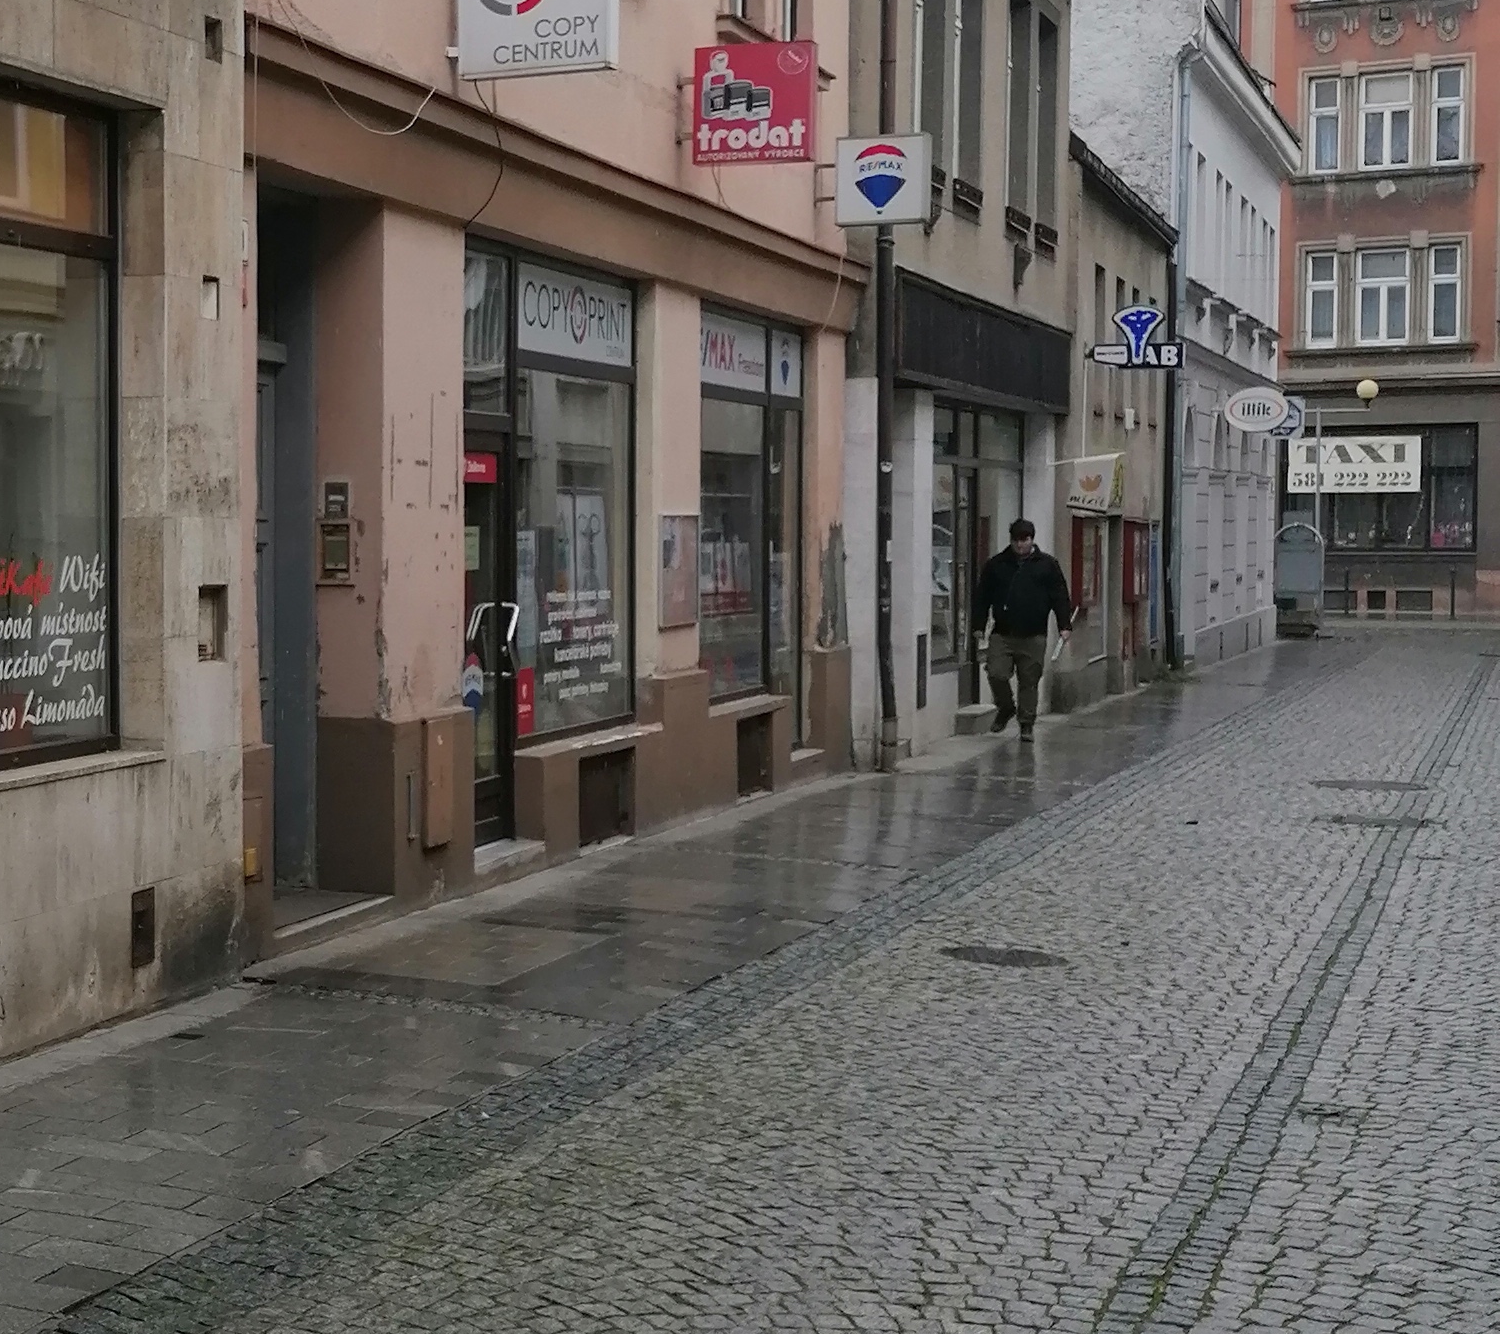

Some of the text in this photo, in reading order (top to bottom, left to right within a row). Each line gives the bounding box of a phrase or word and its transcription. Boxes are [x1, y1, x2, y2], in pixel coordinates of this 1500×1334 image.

[534, 14, 599, 38] COPY
[493, 38, 599, 64] CENTRUM
[697, 118, 806, 151] trodat
[858, 161, 903, 174] RE/MAX
[523, 280, 627, 343] COPY PRINT
[1297, 442, 1409, 464] TAXI
[1334, 471, 1369, 487] 222
[1376, 471, 1412, 487] 222
[59, 552, 106, 602] Wifi
[40, 602, 107, 637] místnost
[49, 635, 106, 687] Fresh
[20, 683, 106, 729] Limonáda
